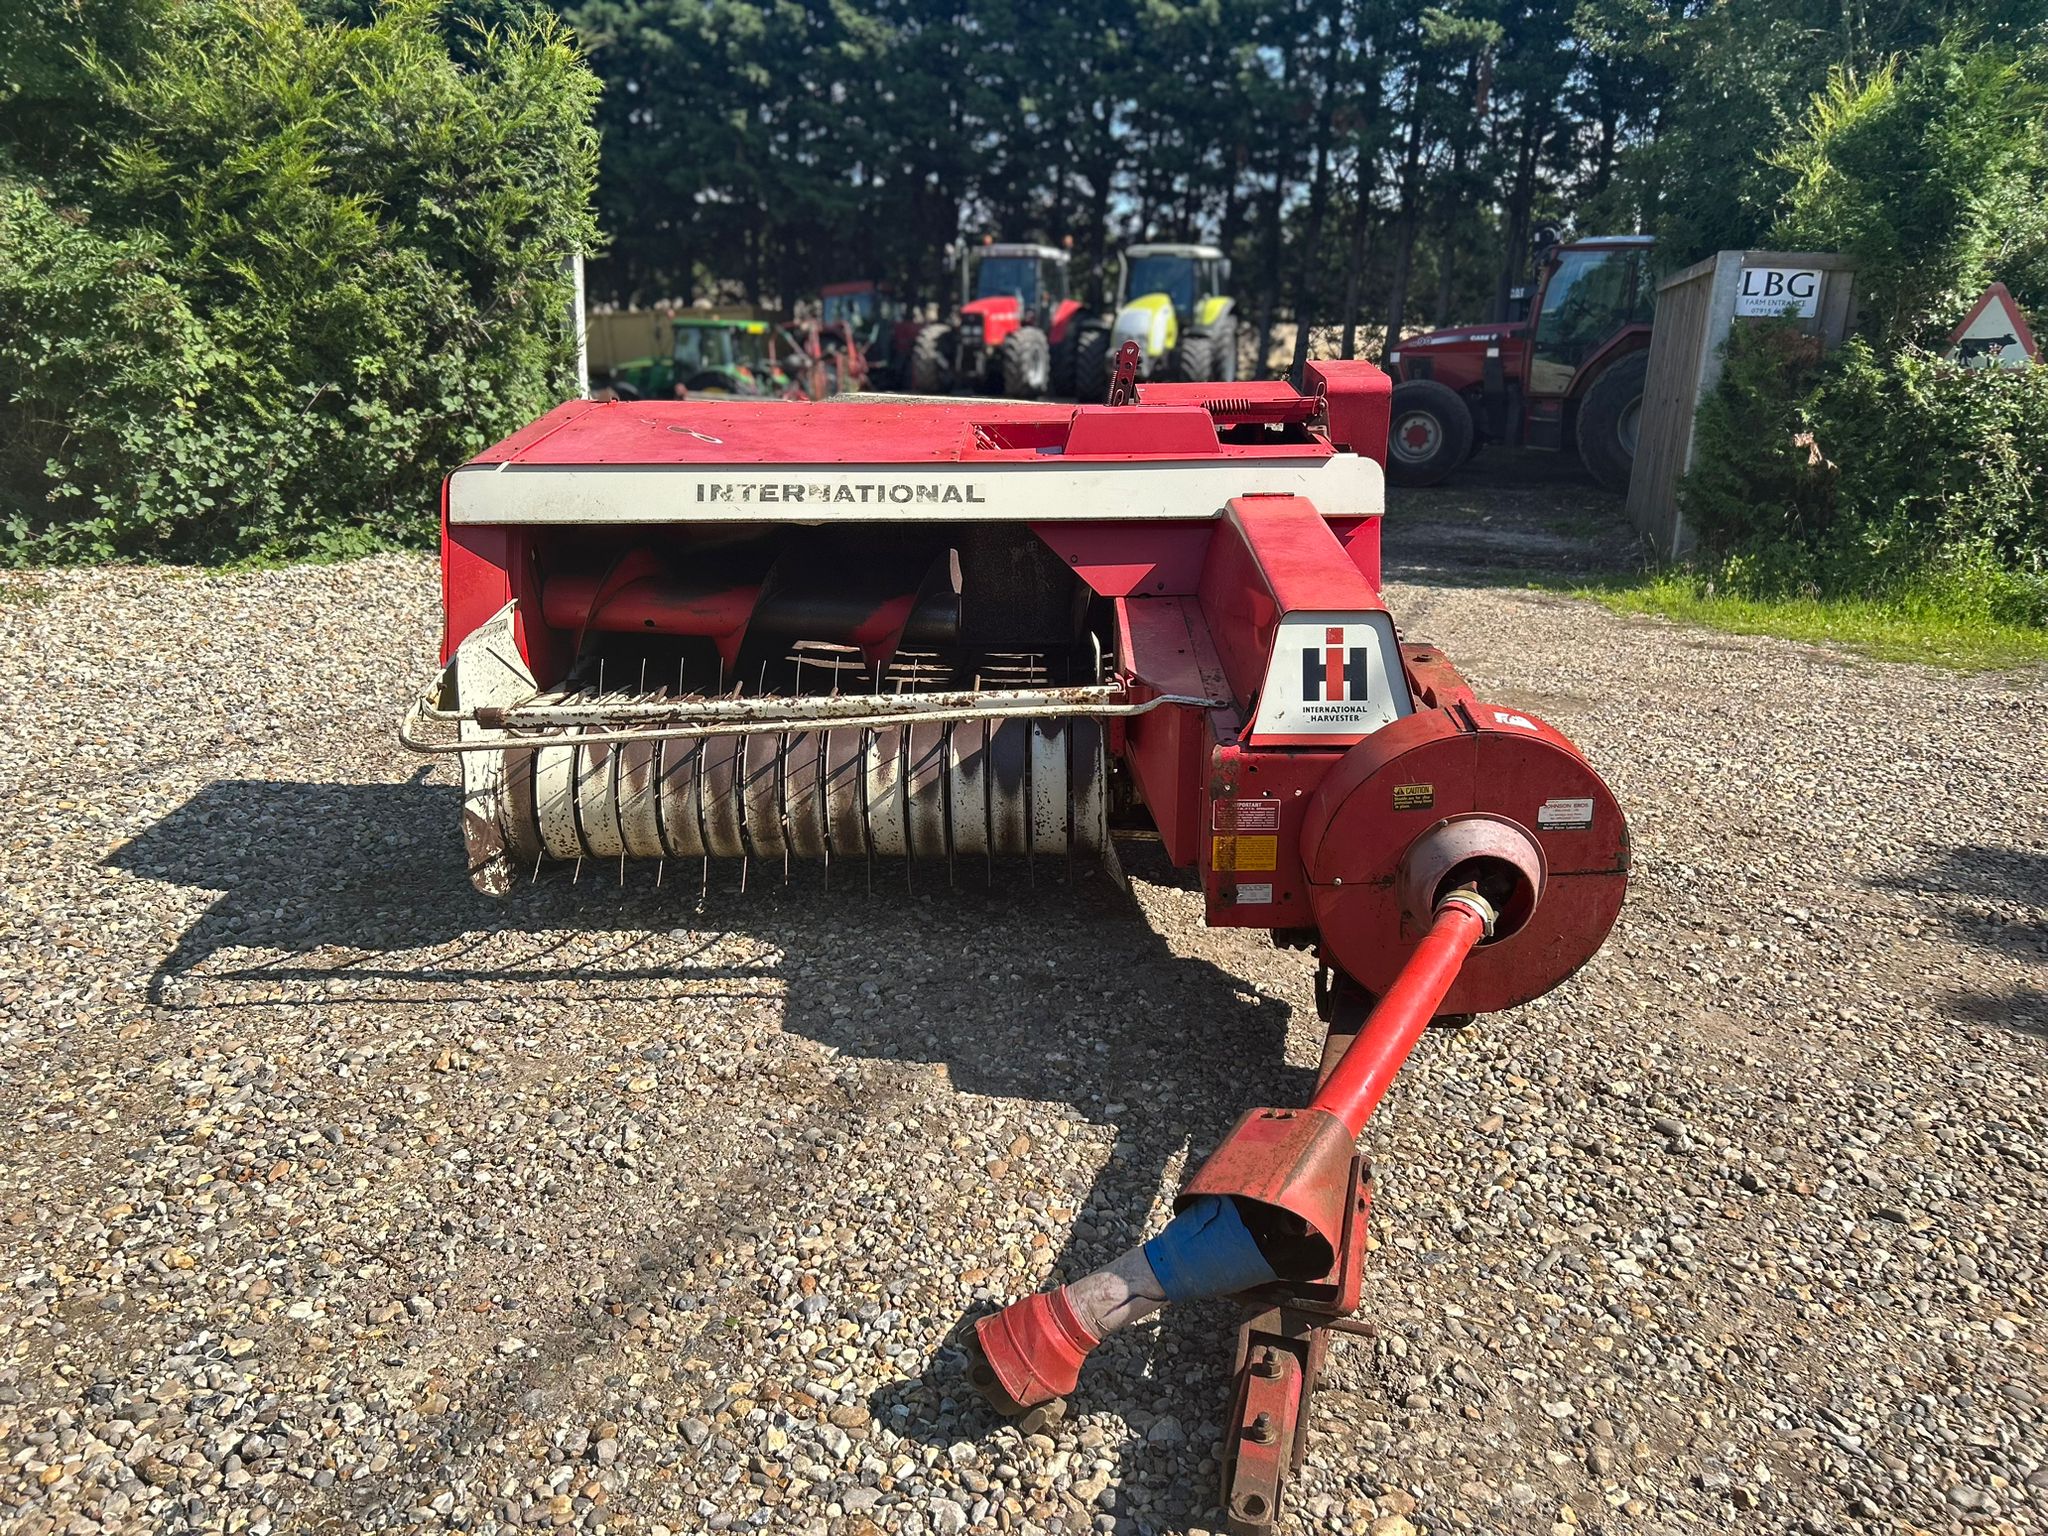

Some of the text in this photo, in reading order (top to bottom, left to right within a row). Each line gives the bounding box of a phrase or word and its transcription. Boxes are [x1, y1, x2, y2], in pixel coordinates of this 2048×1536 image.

[1742, 271, 1815, 298] LBG
[696, 483, 986, 503] INTERNATIONAL
[1302, 706, 1368, 714] INTERNATIONAL
[1310, 714, 1361, 723] HARVESTER
[1405, 786, 1430, 795] CAUTION
